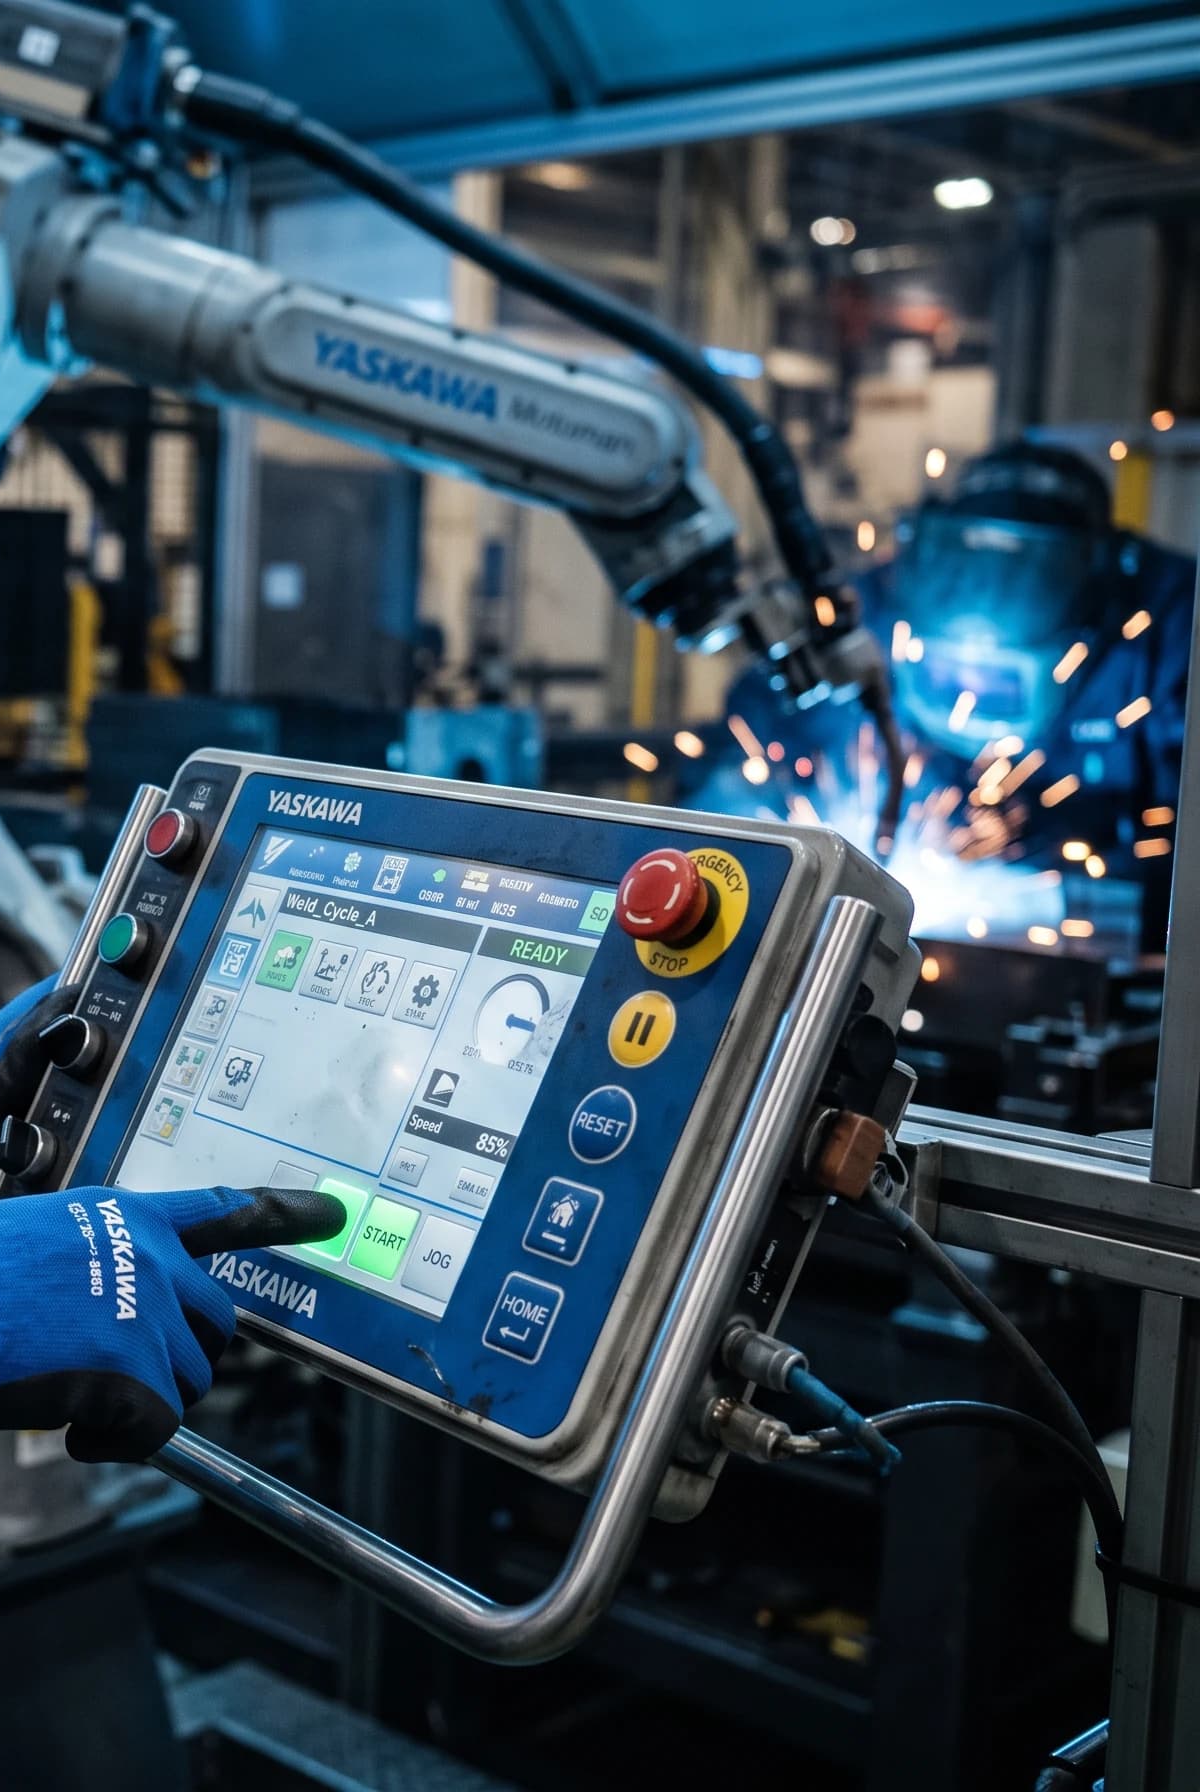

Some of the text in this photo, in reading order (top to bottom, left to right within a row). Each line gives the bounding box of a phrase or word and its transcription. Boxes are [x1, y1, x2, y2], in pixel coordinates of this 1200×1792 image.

[314, 332, 499, 422] YASKAWA
[266, 790, 363, 826] YASKAWA
[286, 892, 377, 928] Weld_Cycle_A
[509, 938, 569, 966] READY
[649, 951, 689, 973] STOP
[408, 1113, 511, 1159] Speed 85%
[575, 1109, 628, 1142] RESET
[362, 1224, 406, 1252] START
[95, 1198, 137, 1321] YASKAWA
[422, 1248, 453, 1270] JOG
[207, 1251, 319, 1320] YASKAWA
[501, 1294, 550, 1328] HOME
